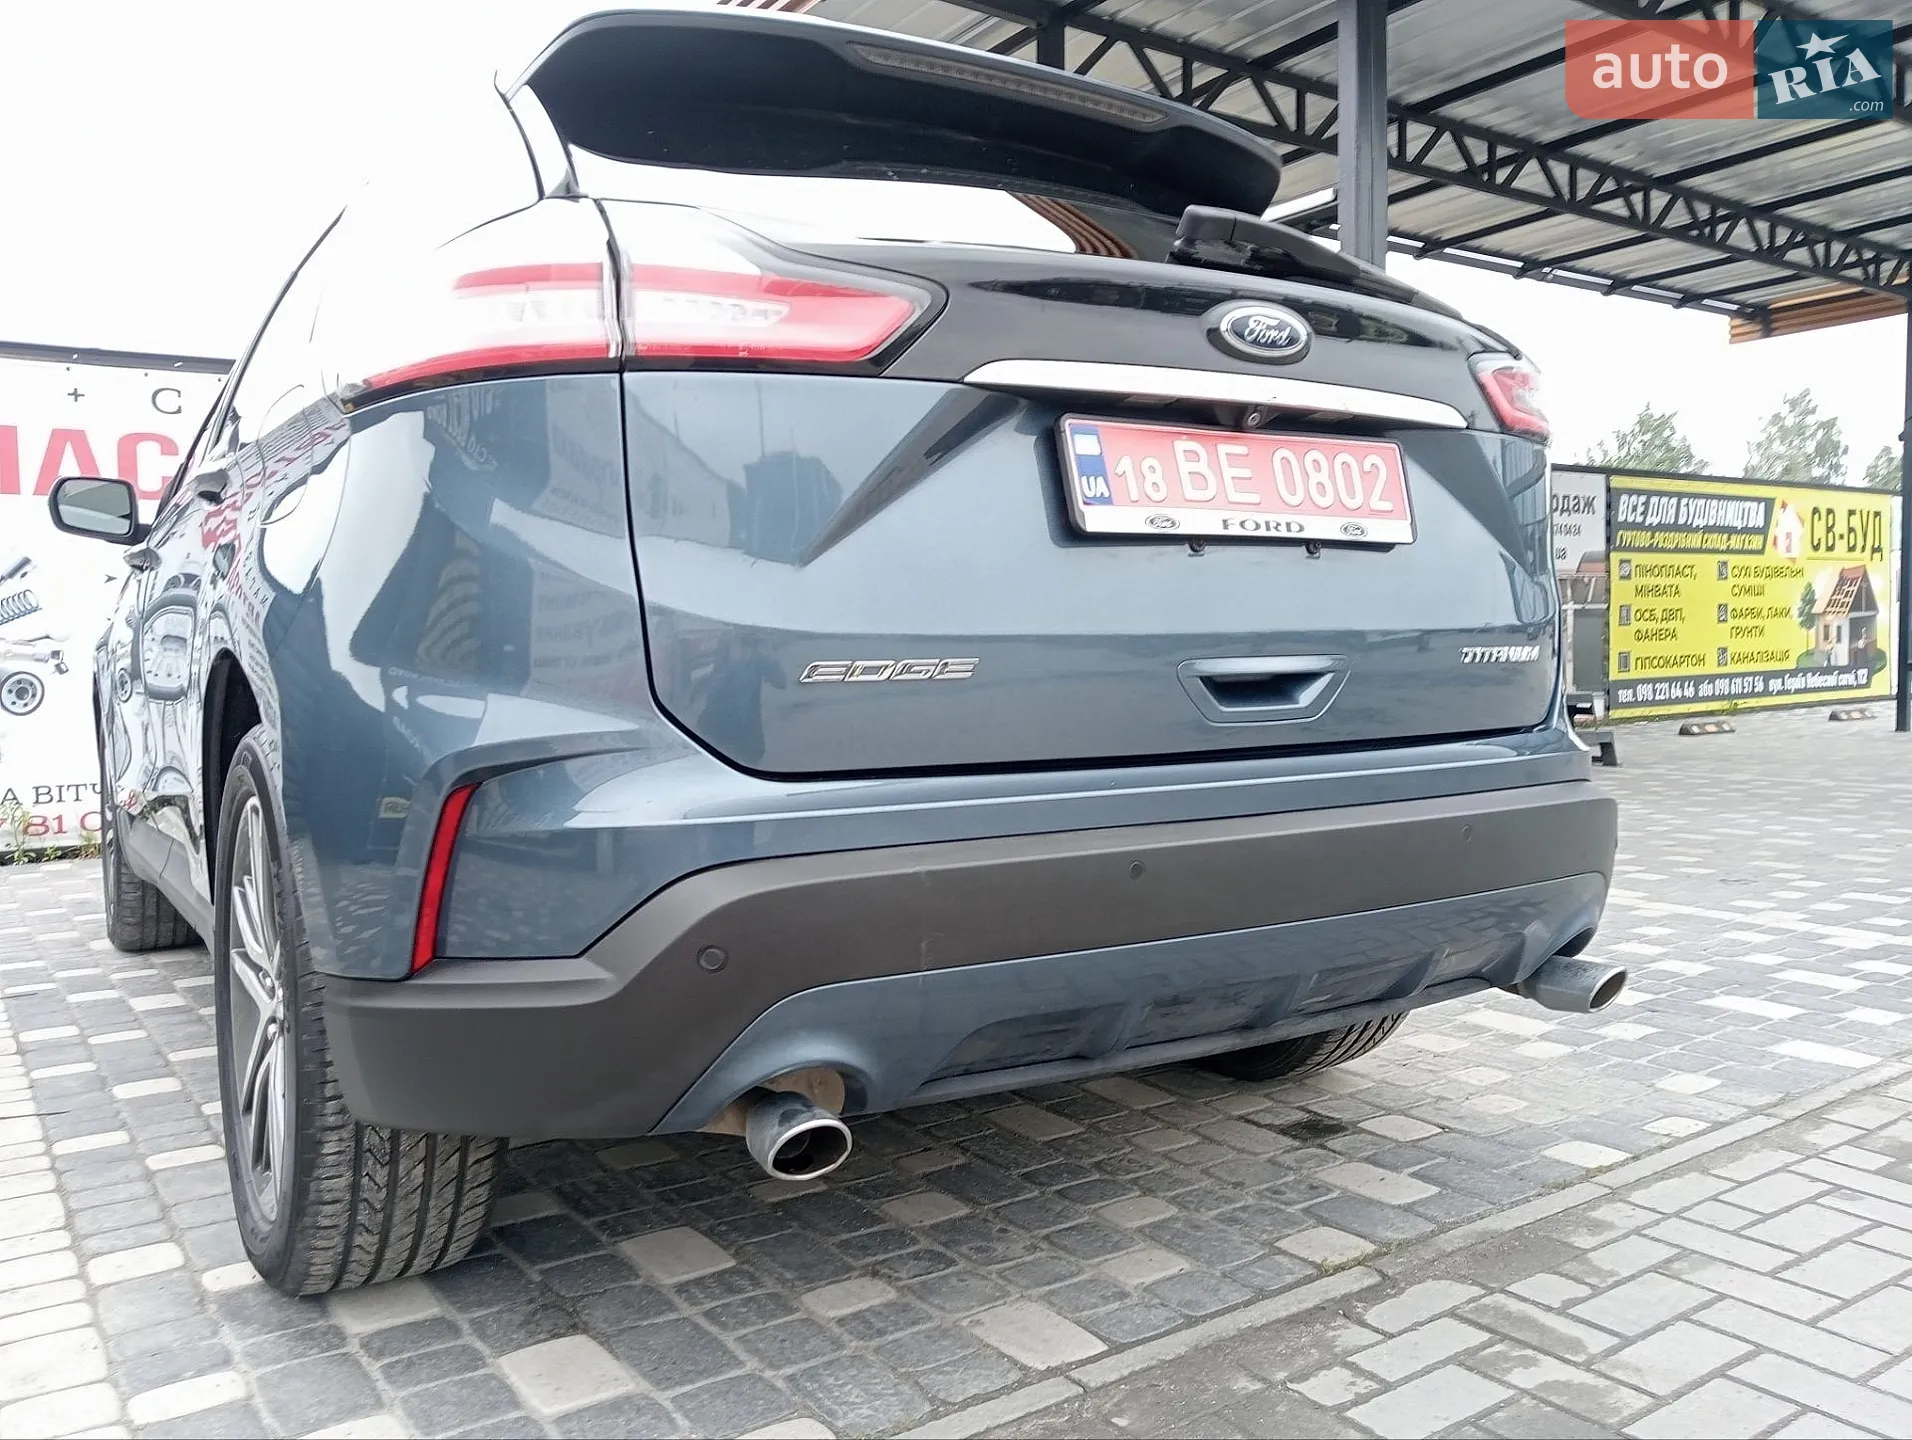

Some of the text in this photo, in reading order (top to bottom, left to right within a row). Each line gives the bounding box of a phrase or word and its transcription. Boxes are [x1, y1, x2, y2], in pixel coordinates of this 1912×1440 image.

[1243, 314, 1293, 347] Ford
[1114, 439, 1394, 513] 18 BE 0802
[1081, 475, 1110, 499] UA
[1617, 494, 1766, 530] ВСЕ ДЛЯ БУДІВНИЦТВА
[1222, 518, 1305, 533] FORD
[1811, 506, 1883, 562] СВ-БУД
[1634, 564, 1697, 580] ПІНОПЛАСТ,
[1634, 584, 1682, 598] МІНВАТА
[1731, 584, 1765, 598] СУМІШІ
[1634, 627, 1678, 643] ФАНЕРА
[1634, 652, 1707, 671] ГІПСОКАРТОН
[1730, 649, 1791, 665] КАНАЛІЗАЦІЯ
[798, 657, 980, 683] EDGE
[1618, 688, 1636, 703] тел.
[1654, 681, 1670, 701] 221
[1683, 680, 1696, 698] 46
[1698, 678, 1714, 697] або
